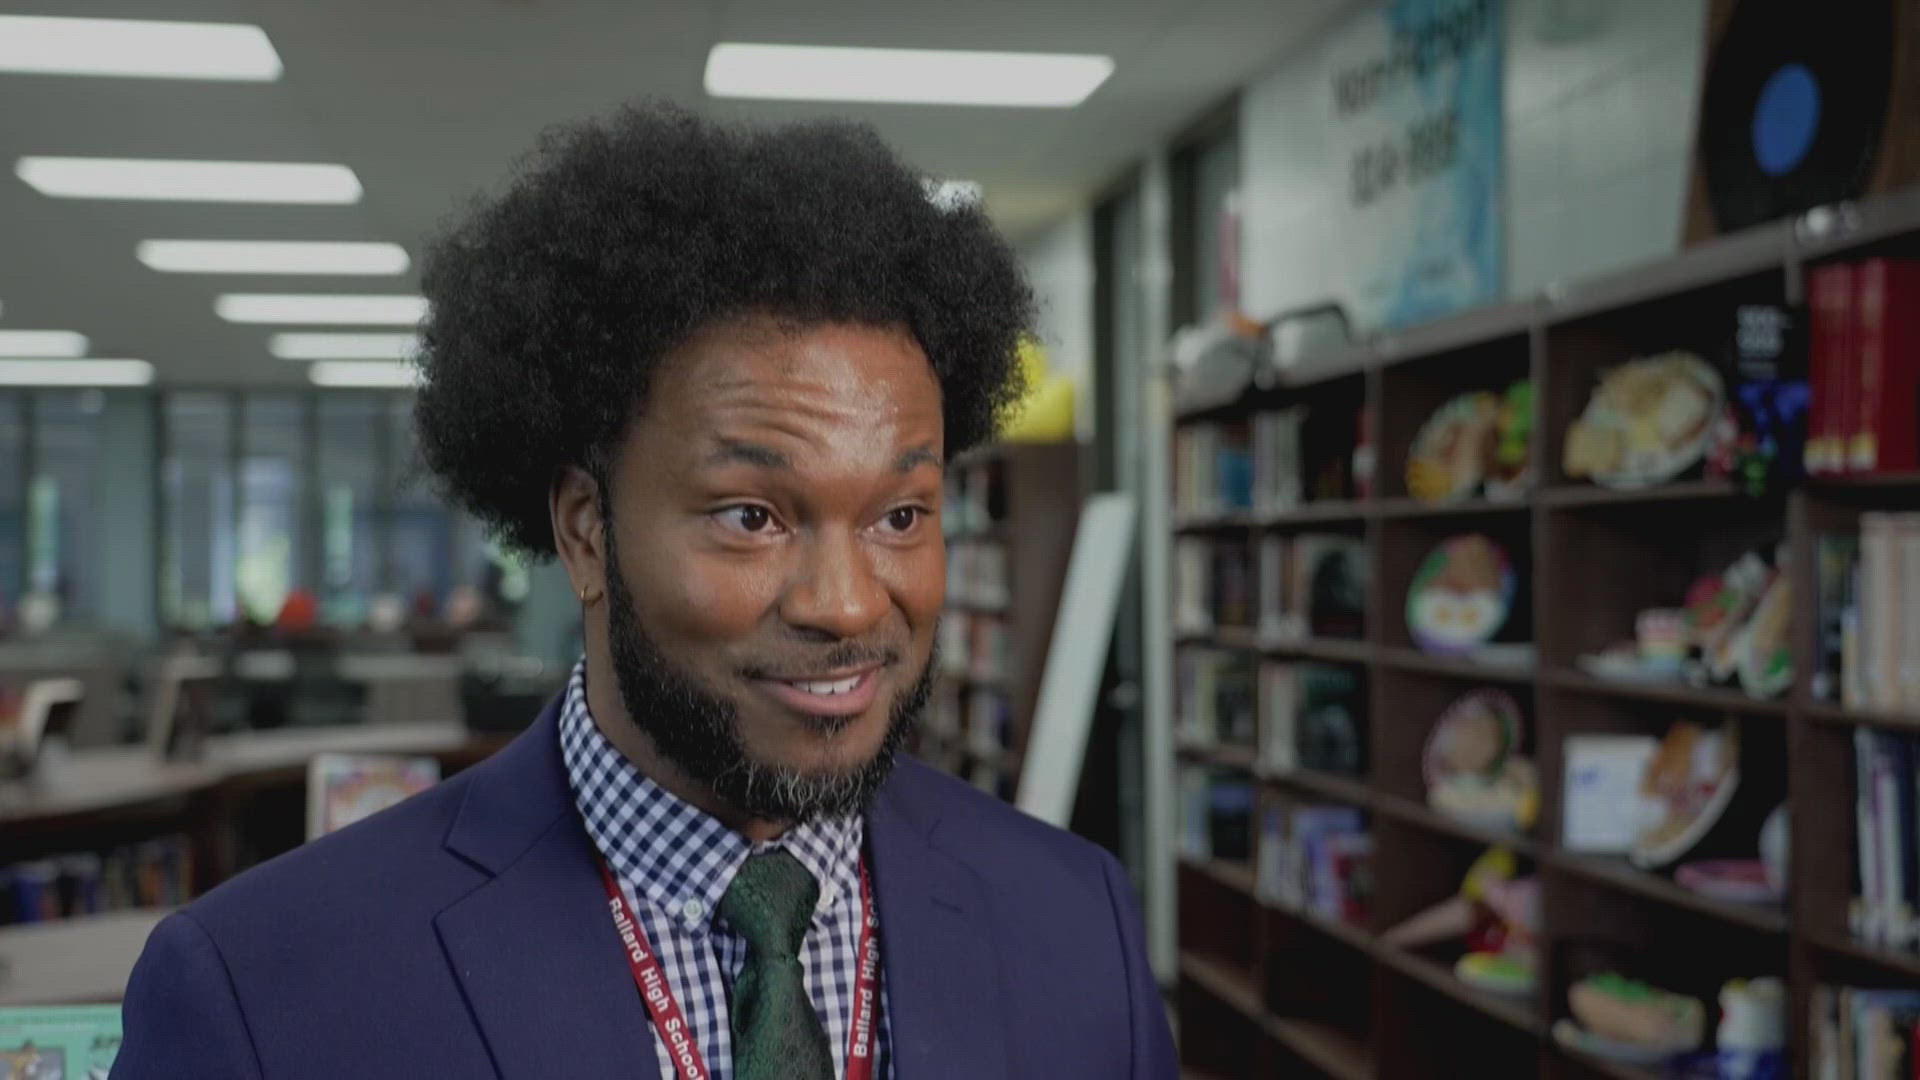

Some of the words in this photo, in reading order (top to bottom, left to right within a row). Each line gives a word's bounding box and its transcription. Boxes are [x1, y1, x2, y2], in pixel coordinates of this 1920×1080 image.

[609, 896, 649, 963] Ballard
[641, 966, 670, 1013] High
[861, 937, 880, 980] High
[853, 987, 873, 1058] Ballard
